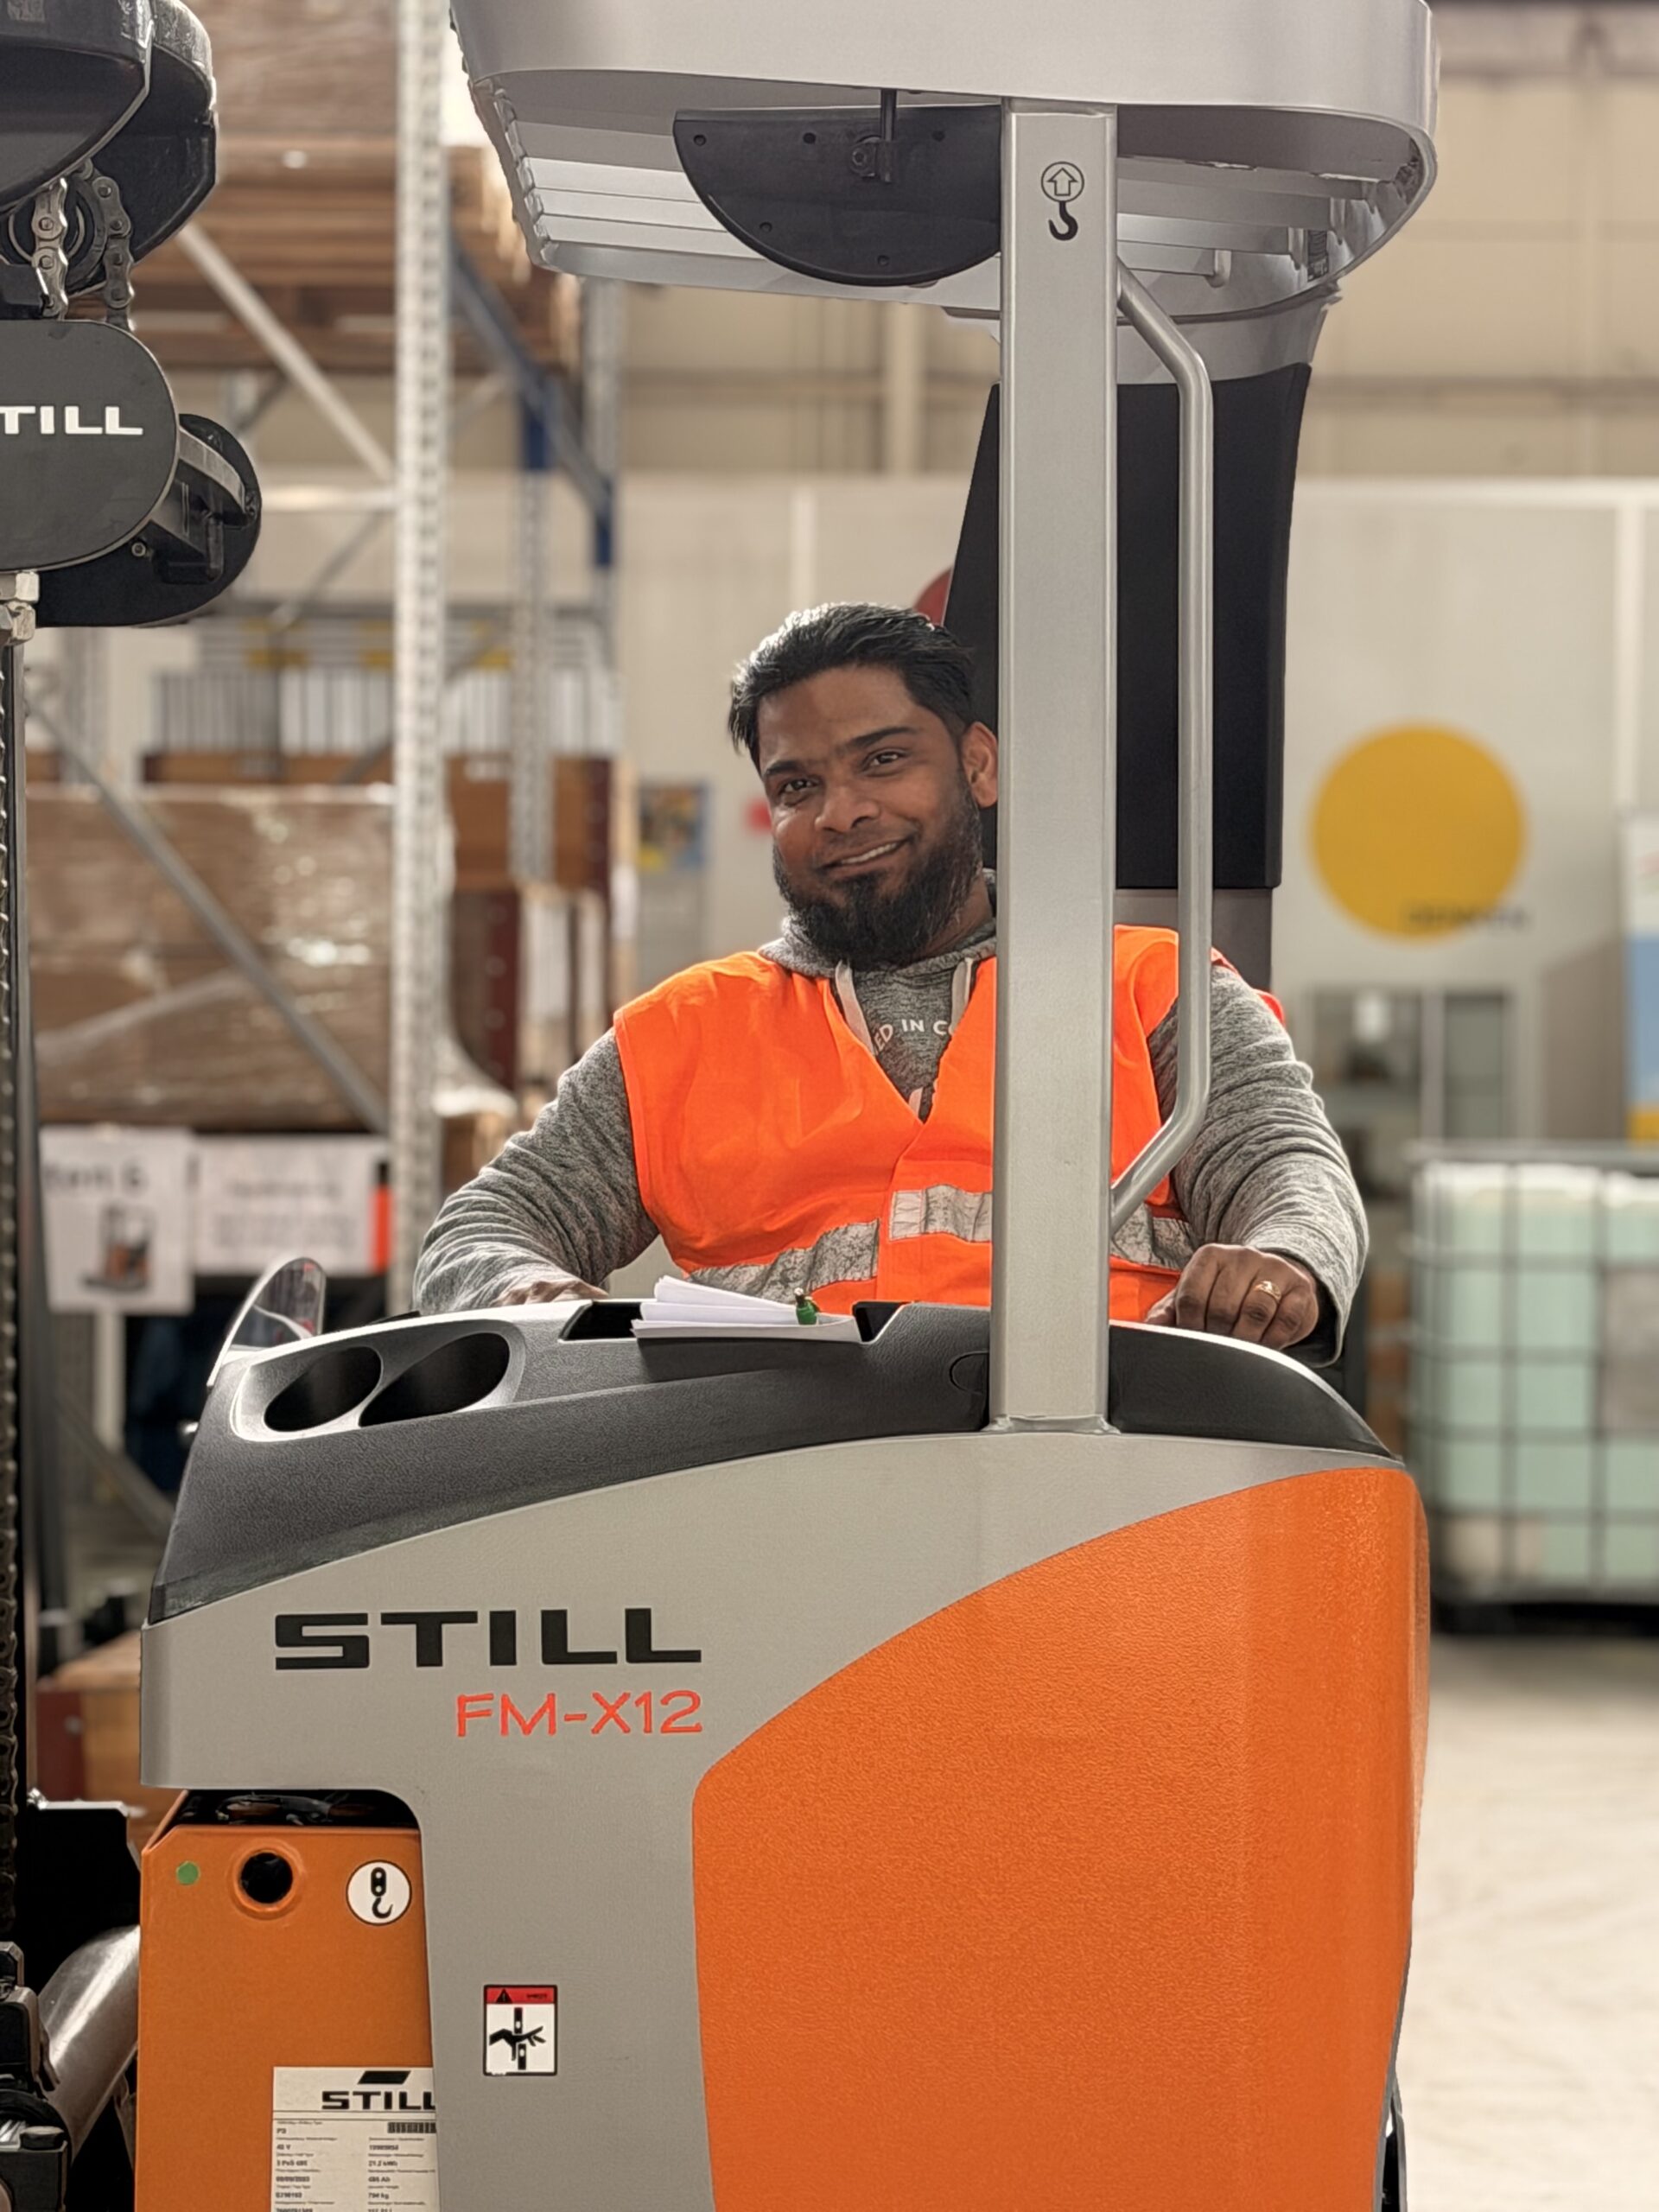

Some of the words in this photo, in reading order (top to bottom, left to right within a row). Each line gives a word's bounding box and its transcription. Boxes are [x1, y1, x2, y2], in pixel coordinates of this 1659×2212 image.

[0, 406, 143, 435] TILL
[874, 1024, 893, 1056] ED
[901, 1019, 925, 1032] IN
[933, 1020, 954, 1036] C
[275, 1608, 702, 1669] STILL
[456, 1690, 702, 1736] FM-X12
